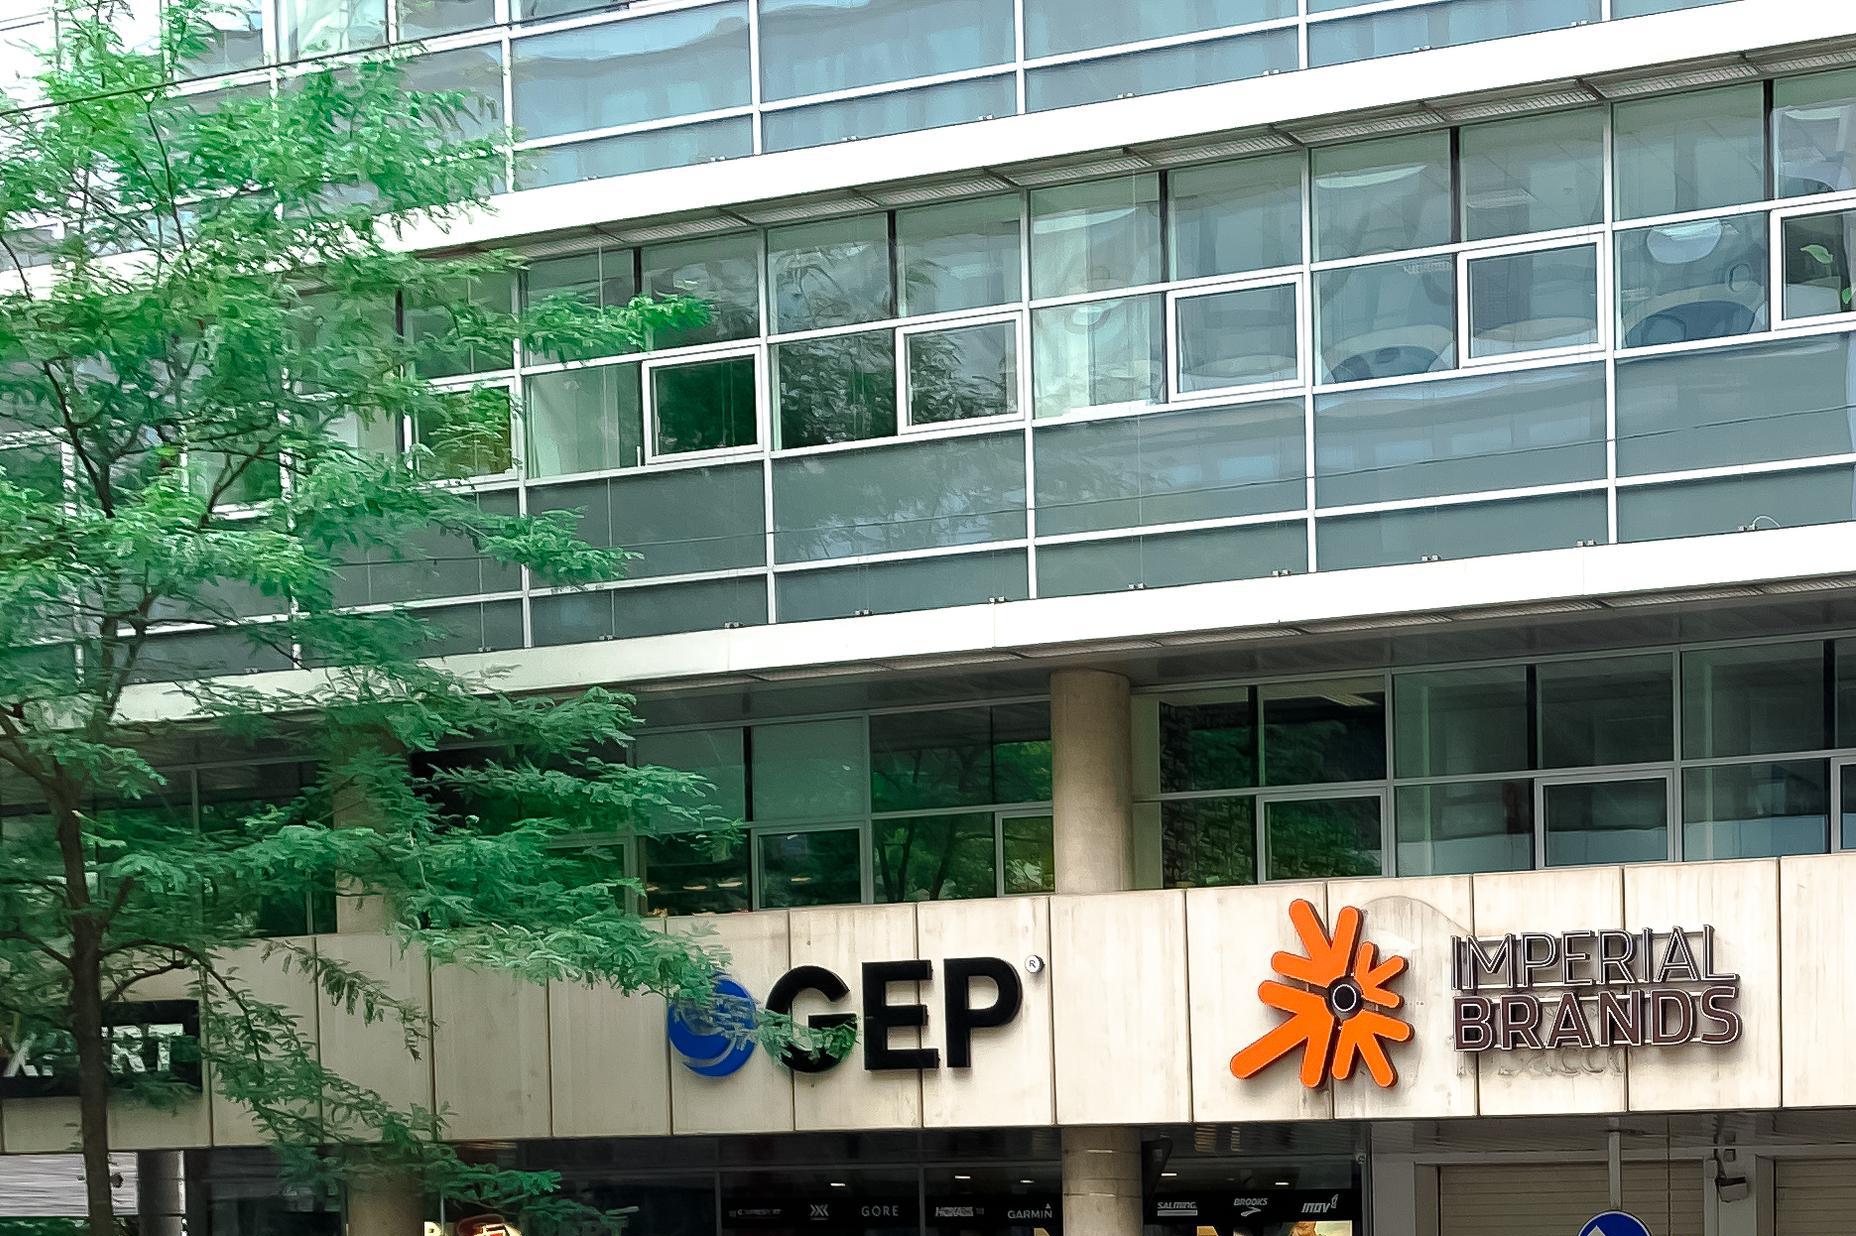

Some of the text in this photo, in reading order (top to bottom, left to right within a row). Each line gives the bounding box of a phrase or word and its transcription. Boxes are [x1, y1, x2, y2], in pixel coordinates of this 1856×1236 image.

[1450, 923, 1740, 991] IMPERIAL
[765, 956, 1024, 1073] GEP
[1453, 986, 1743, 1052] BRANDS
[861, 1205, 899, 1217] GORE
[1007, 1209, 1053, 1219] GARMIN
[1233, 1197, 1268, 1206] BROOKS
